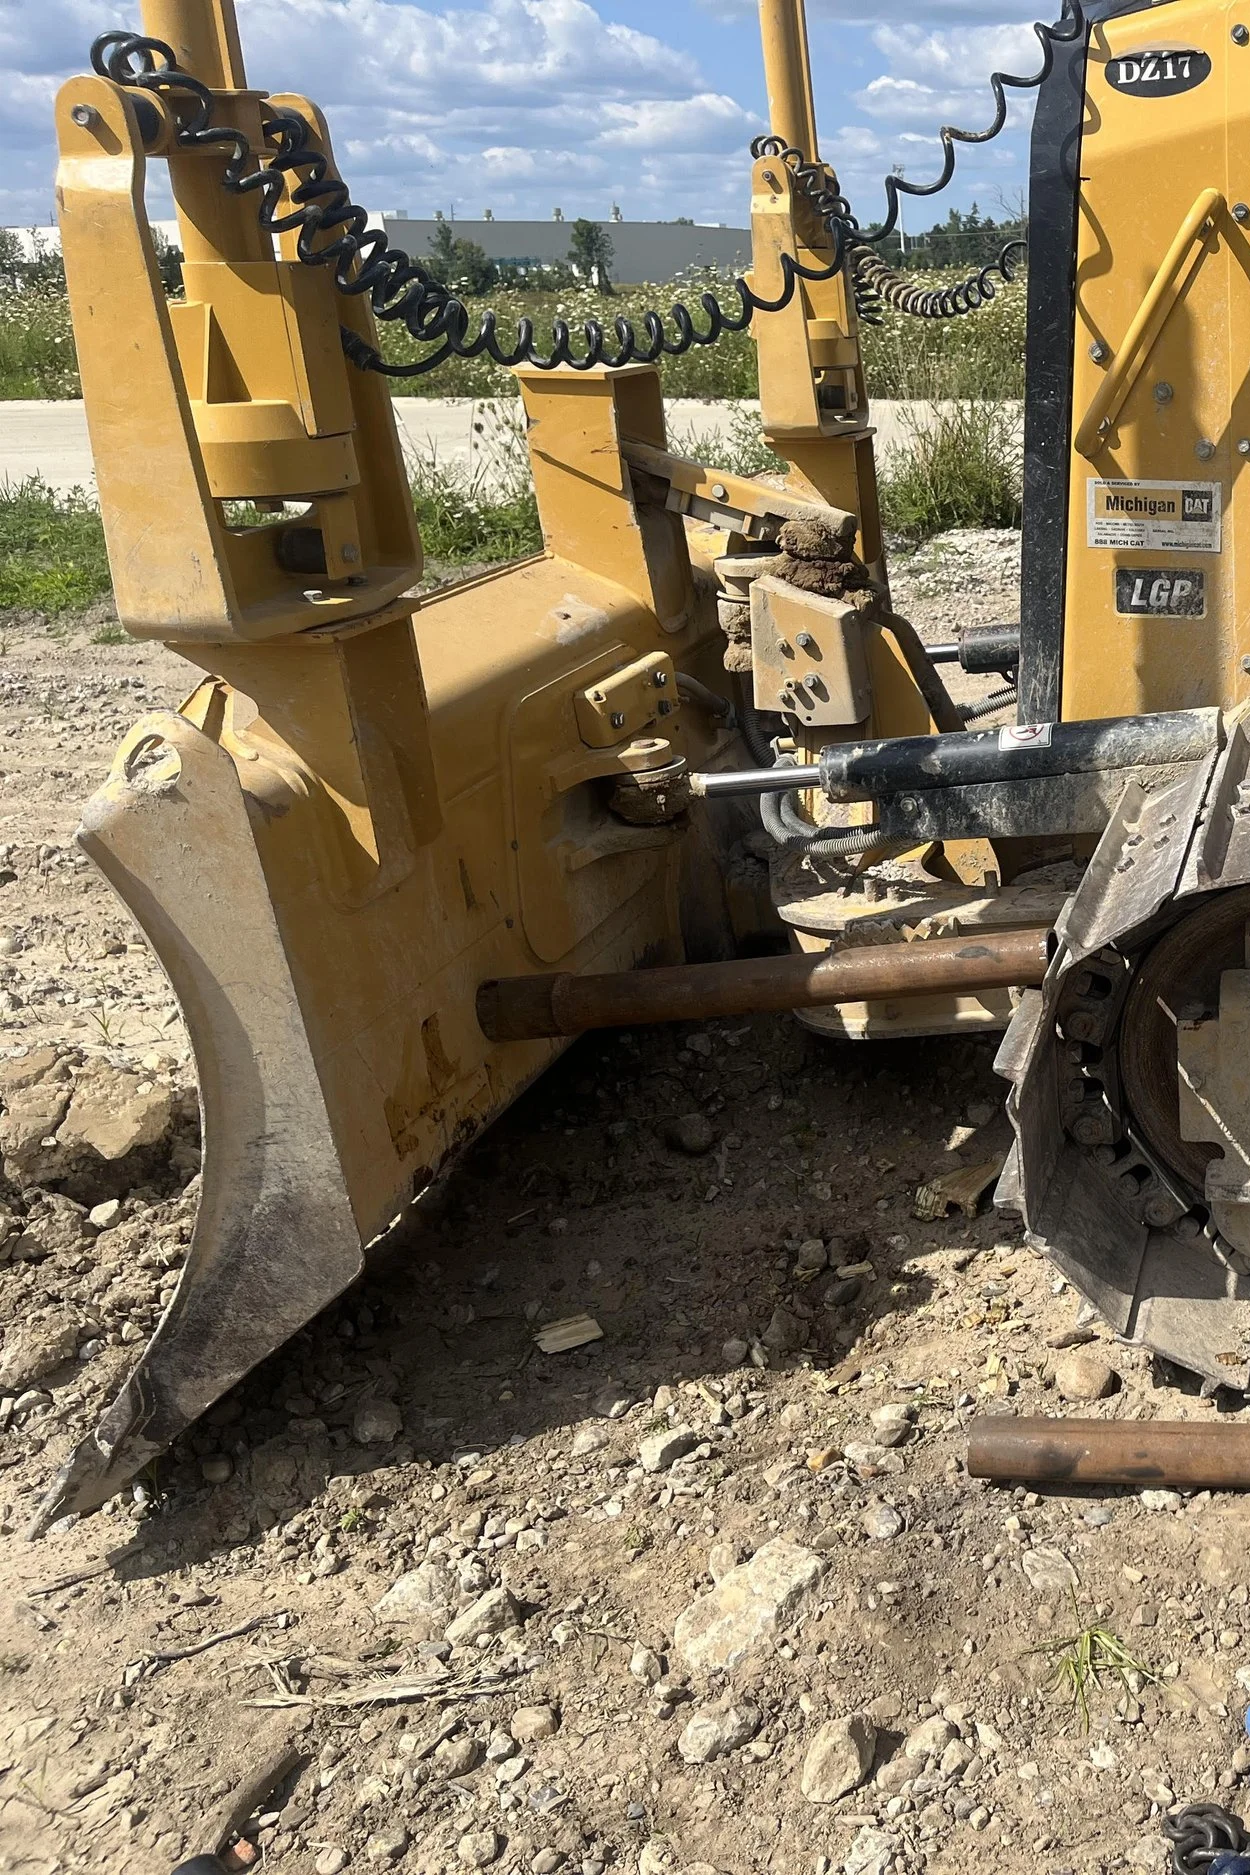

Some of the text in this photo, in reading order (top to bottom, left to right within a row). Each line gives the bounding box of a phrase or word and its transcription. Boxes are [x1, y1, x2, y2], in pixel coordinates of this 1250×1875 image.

[1117, 54, 1191, 84] DZ17
[1105, 495, 1175, 516] Michigan
[1184, 498, 1210, 514] CAT
[1130, 578, 1192, 607] LGP
